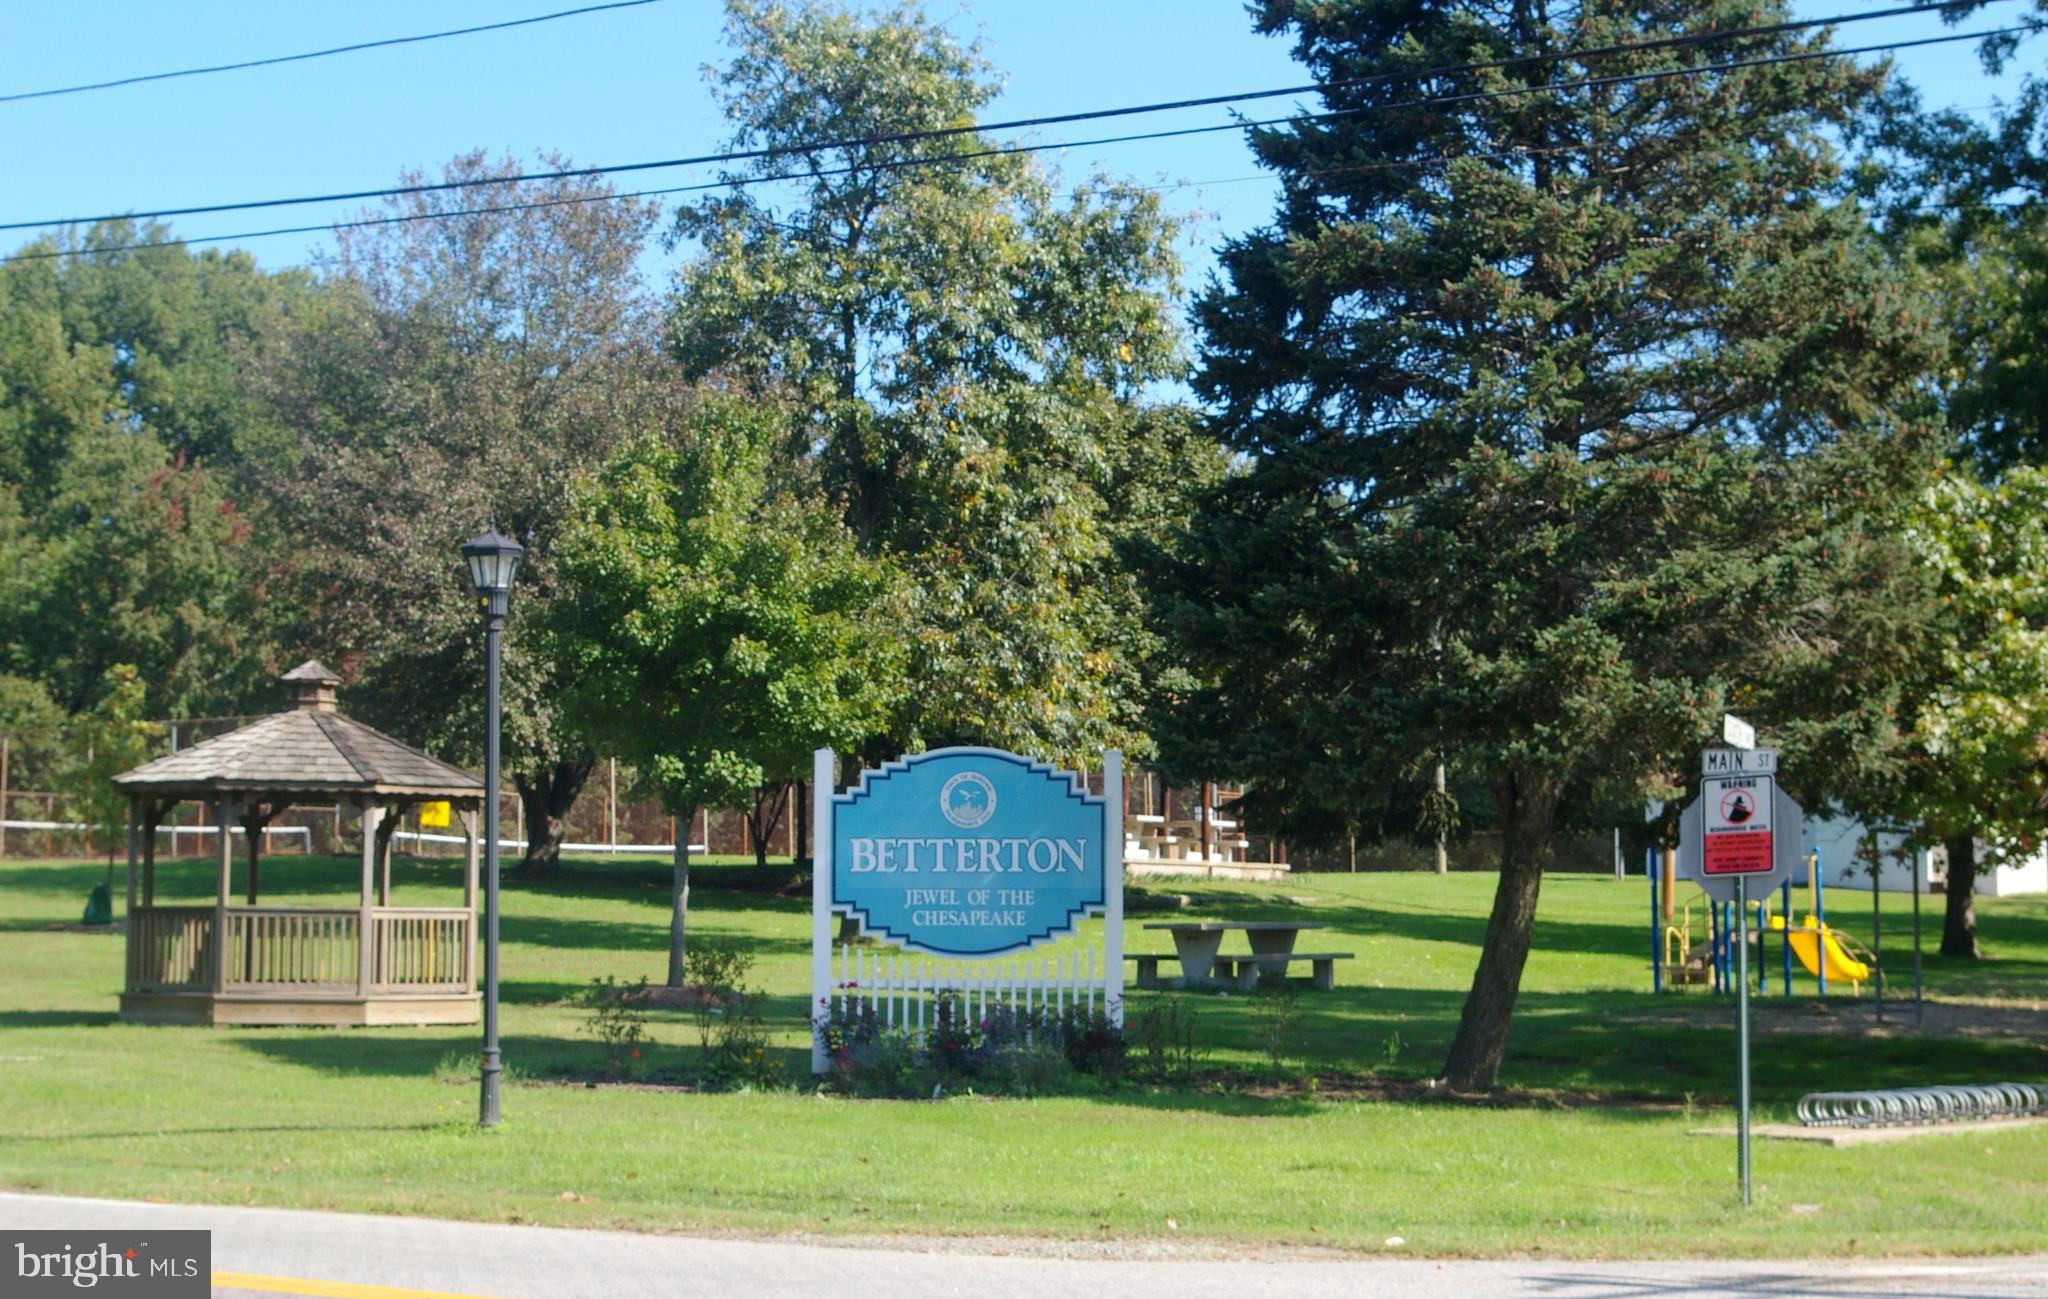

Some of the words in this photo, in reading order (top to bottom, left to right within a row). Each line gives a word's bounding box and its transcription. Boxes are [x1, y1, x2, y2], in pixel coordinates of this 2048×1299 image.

[1708, 752, 1743, 770] MAIN
[1758, 753, 1769, 767] ST
[850, 838, 1087, 873] BETTERTON
[904, 889, 960, 908] JEWEL
[968, 889, 990, 906] OF
[997, 889, 1035, 906] THE
[912, 910, 1026, 926] CHESAPEAKE
